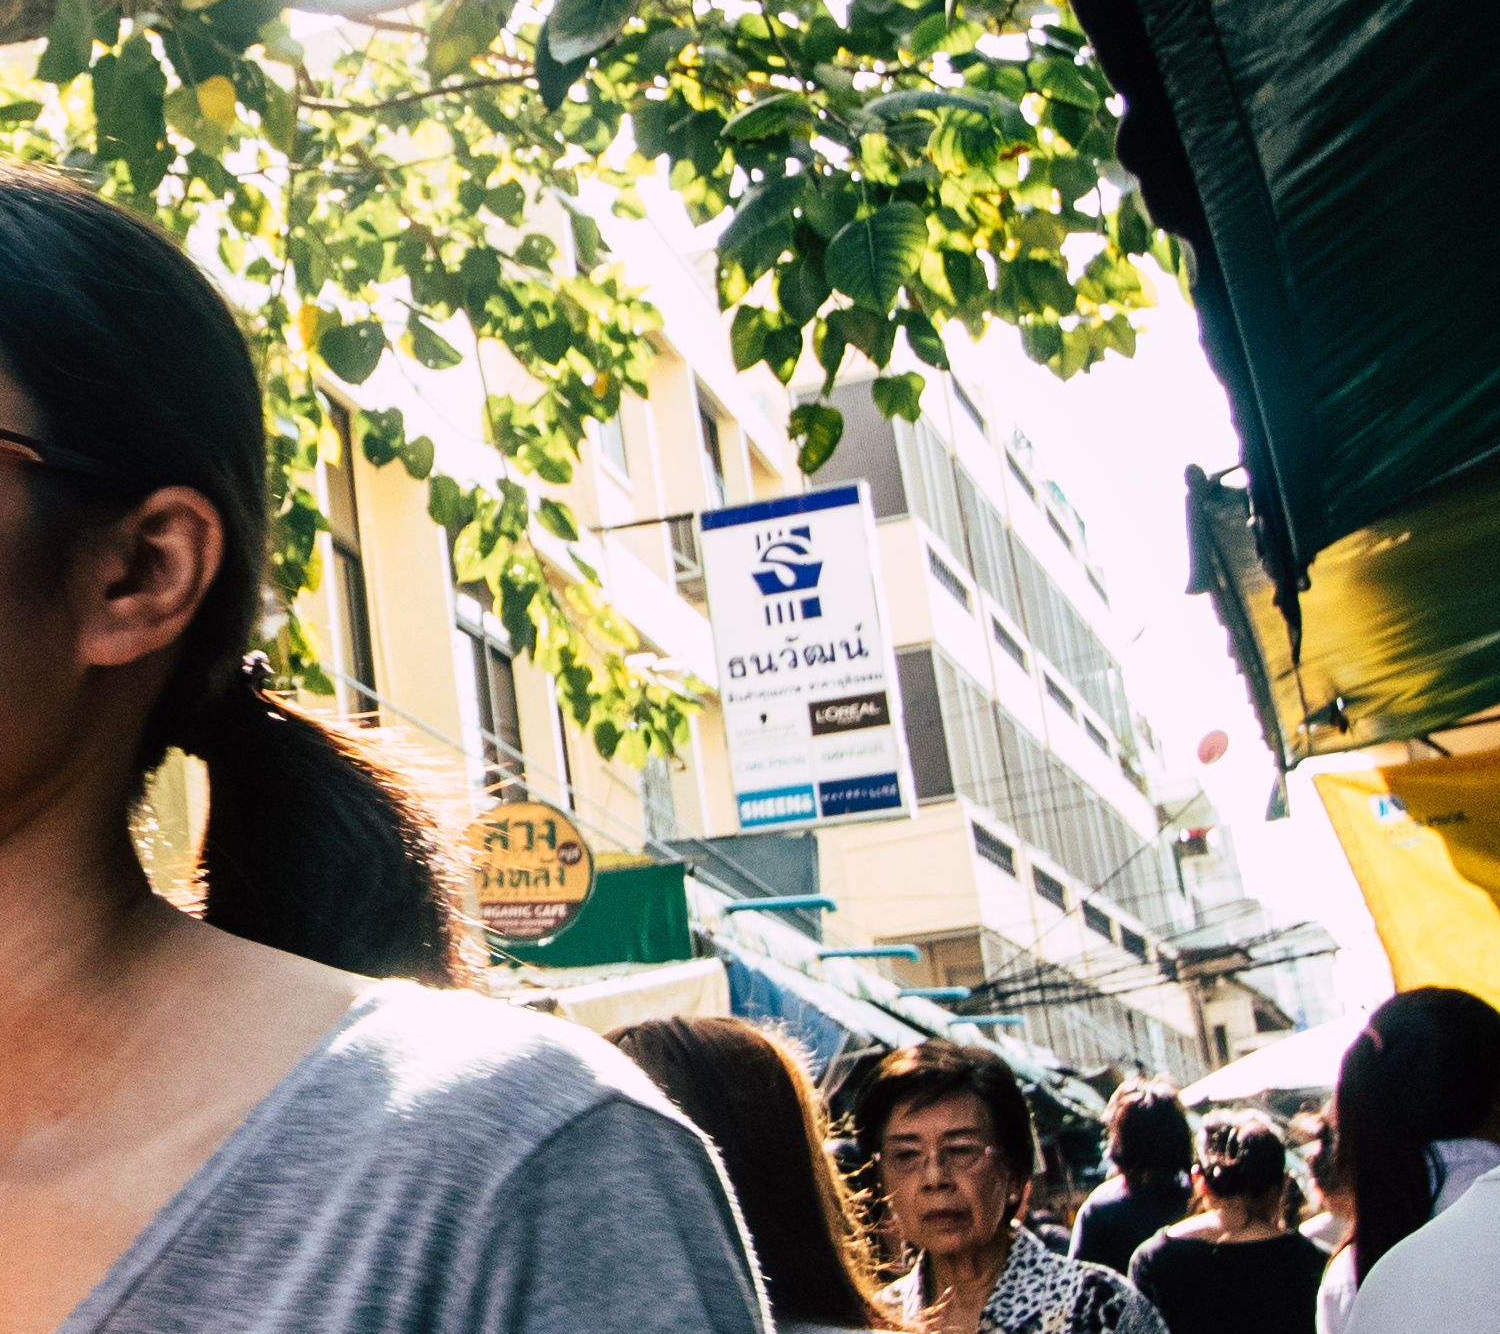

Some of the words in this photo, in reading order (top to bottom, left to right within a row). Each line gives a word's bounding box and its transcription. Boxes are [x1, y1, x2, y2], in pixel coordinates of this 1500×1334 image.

[727, 622, 870, 681] ธนวัฒน์
[478, 903, 532, 918] RGANIC
